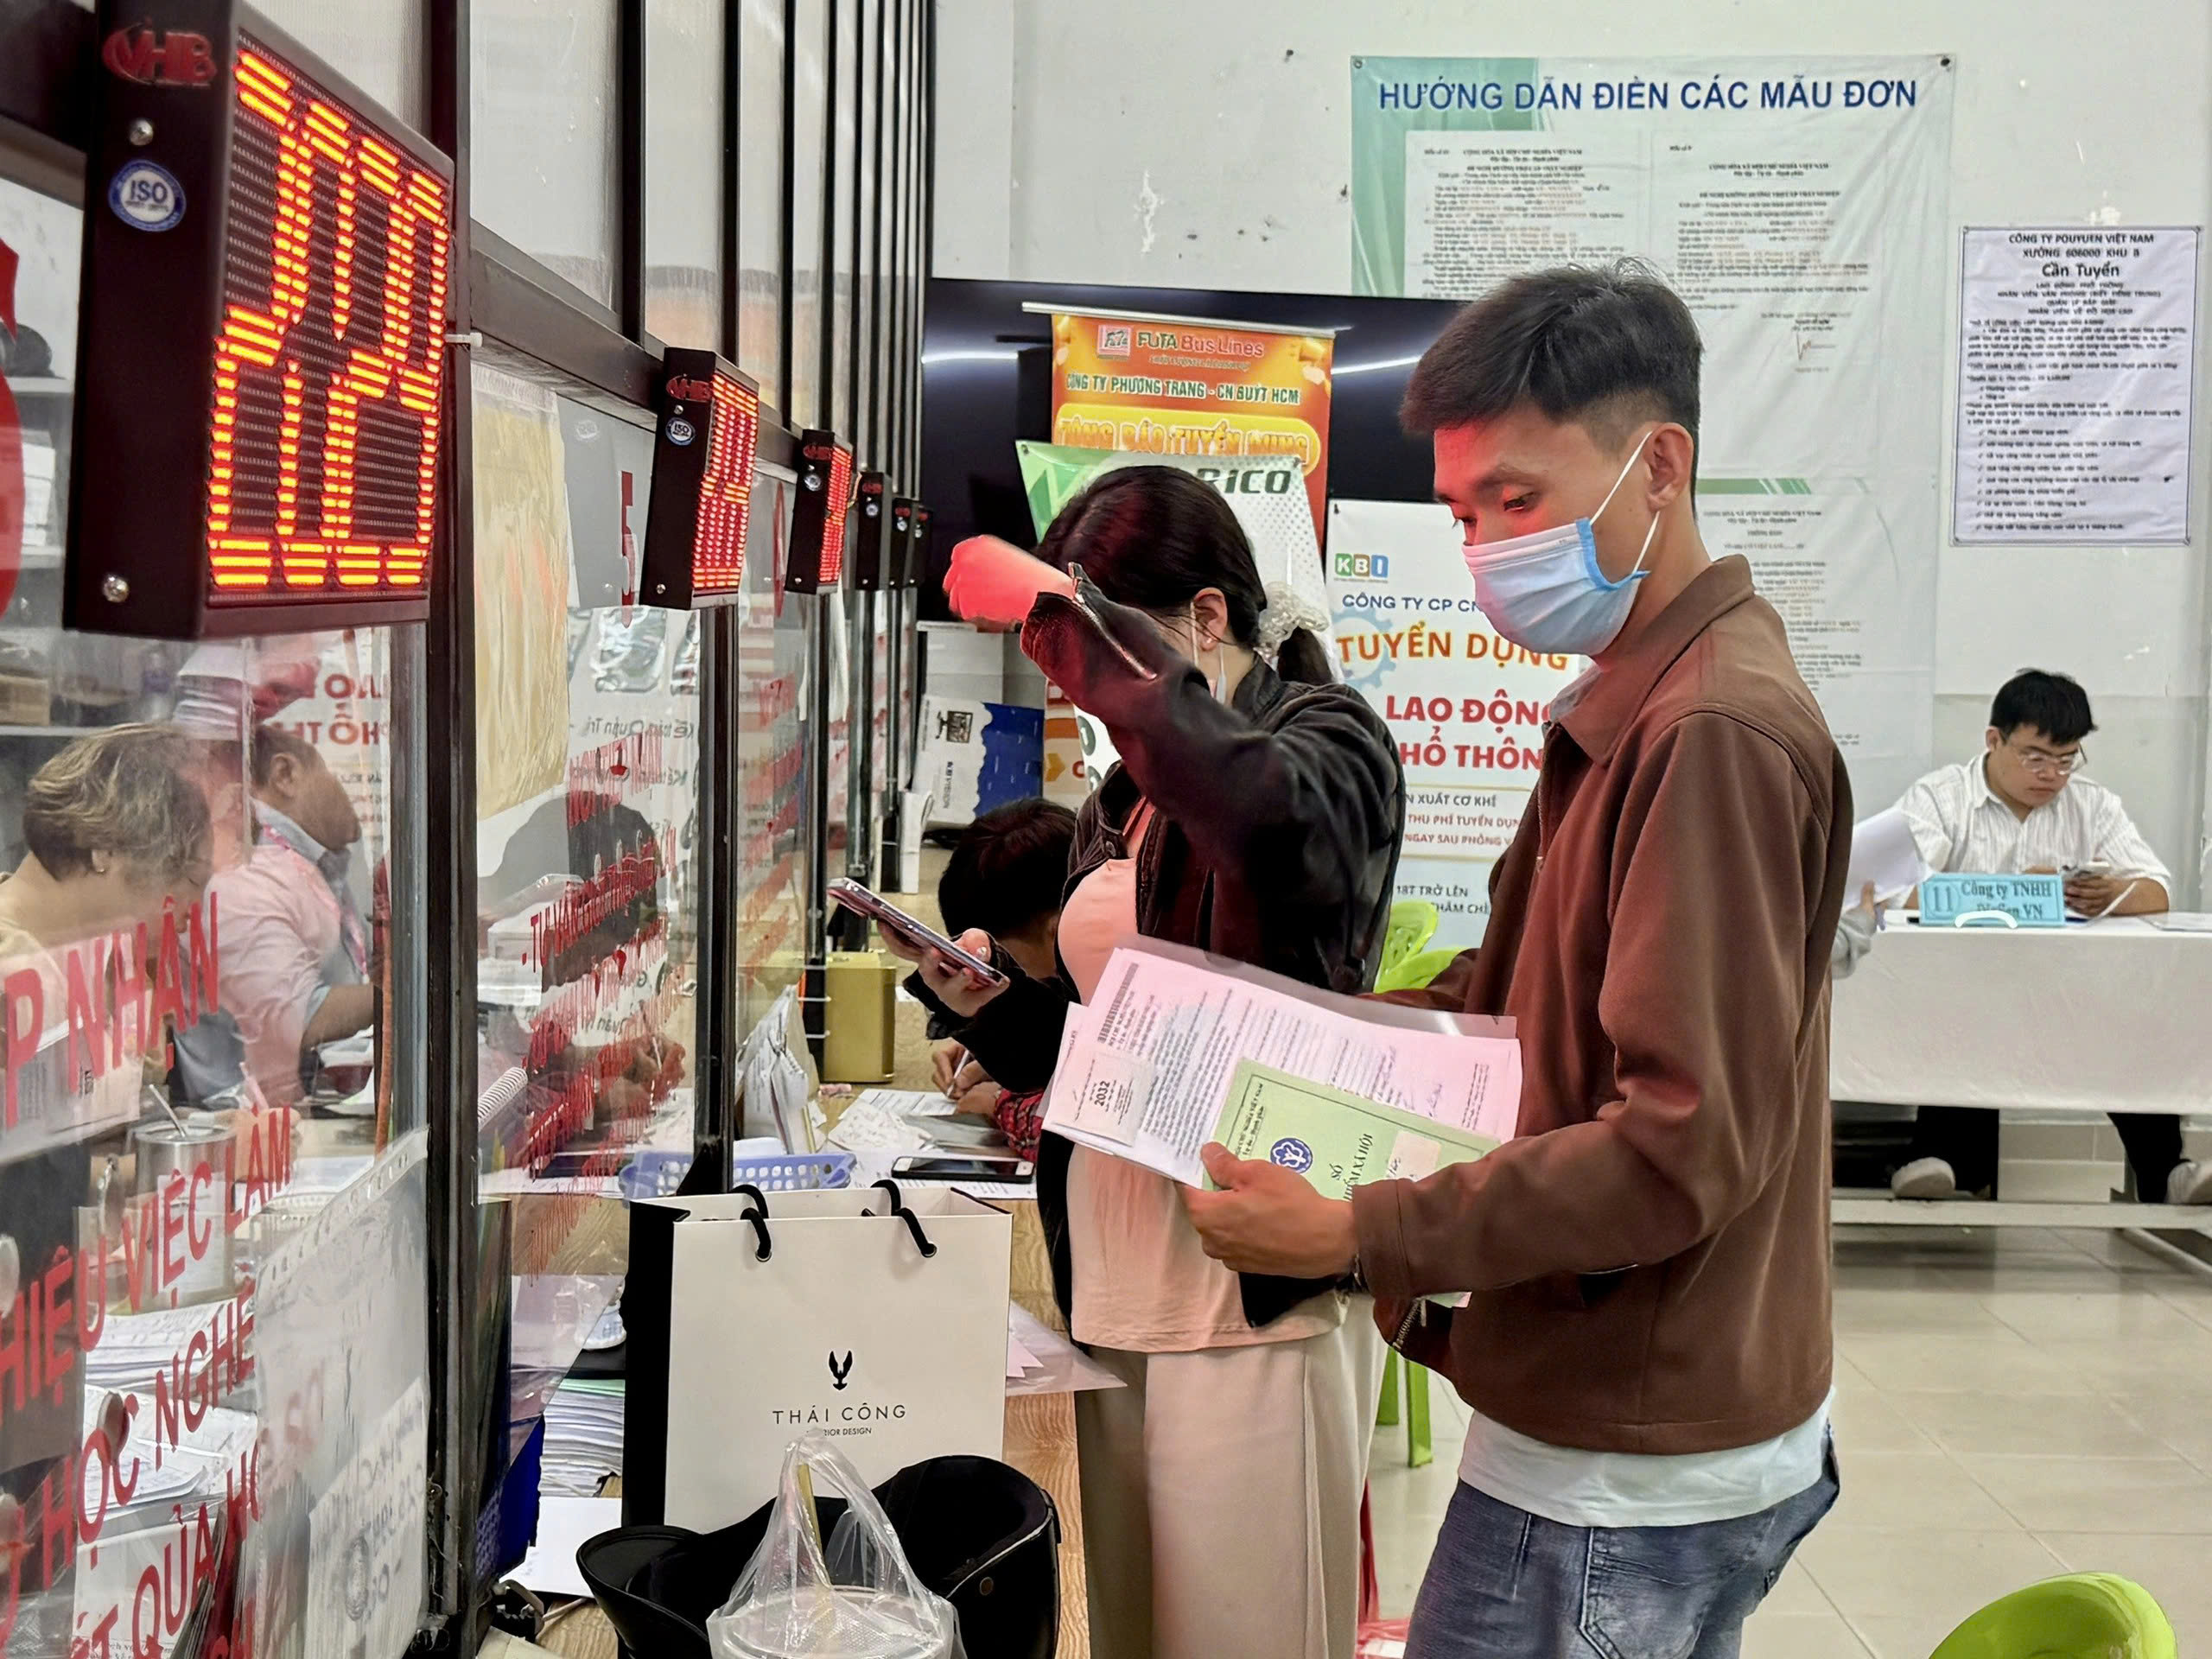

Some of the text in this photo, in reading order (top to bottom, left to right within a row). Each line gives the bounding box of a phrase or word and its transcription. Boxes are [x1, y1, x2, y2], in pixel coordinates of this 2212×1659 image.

[1379, 74, 1917, 111] HƯỚNG DẪN ĐIỀN CÁC MẪU ĐƠN
[130, 179, 168, 203] ISO
[2009, 232, 2037, 244] CÔNG
[2041, 233, 2052, 244] TY
[2106, 232, 2126, 245] VIỆT
[2129, 233, 2154, 244] NAM
[2023, 246, 2060, 257] XƯỞNG
[2106, 248, 2127, 257] KHU
[2042, 260, 2120, 280] Cần Tuyển
[207, 47, 449, 589] 2029
[1136, 331, 1265, 357] FUTA Bus Lines
[1066, 372, 1089, 391] CÔNG
[1092, 375, 1107, 391] TY
[1165, 381, 1205, 398] TRANG
[1217, 385, 1235, 401] CN
[1271, 388, 1300, 405] HCM
[1336, 554, 1388, 577] KBI
[1342, 592, 1396, 609] CÔNG
[1401, 597, 1423, 611] TY
[1427, 598, 1452, 612] CP
[1336, 619, 1569, 671] TUYỂN DỤNG
[1385, 695, 1453, 722] LAO
[1400, 726, 1544, 770] HỔ THÔN
[1417, 791, 1451, 806] XUẤT
[1452, 795, 1471, 807] CƠ
[1473, 795, 1497, 808] KHÍ
[1408, 814, 1430, 824] THU
[1433, 814, 1453, 825] PHÍ
[1457, 814, 1493, 827] TUYỂN
[1404, 834, 1435, 843] NGAY
[1437, 835, 1459, 844] SAU
[1419, 883, 1444, 896] TRỞ
[1446, 885, 1469, 897] LÊN
[1933, 880, 2052, 912] 11 Công ty TNHH
[2022, 904, 2043, 919] VN
[67, 892, 219, 1094] NHẬN
[1093, 1080, 1111, 1107] 2032
[0, 1104, 290, 1427] HIỆU VIỆC LÀM
[772, 1402, 906, 1425] THÁI CÔNG
[842, 1427, 873, 1436] DESIGN
